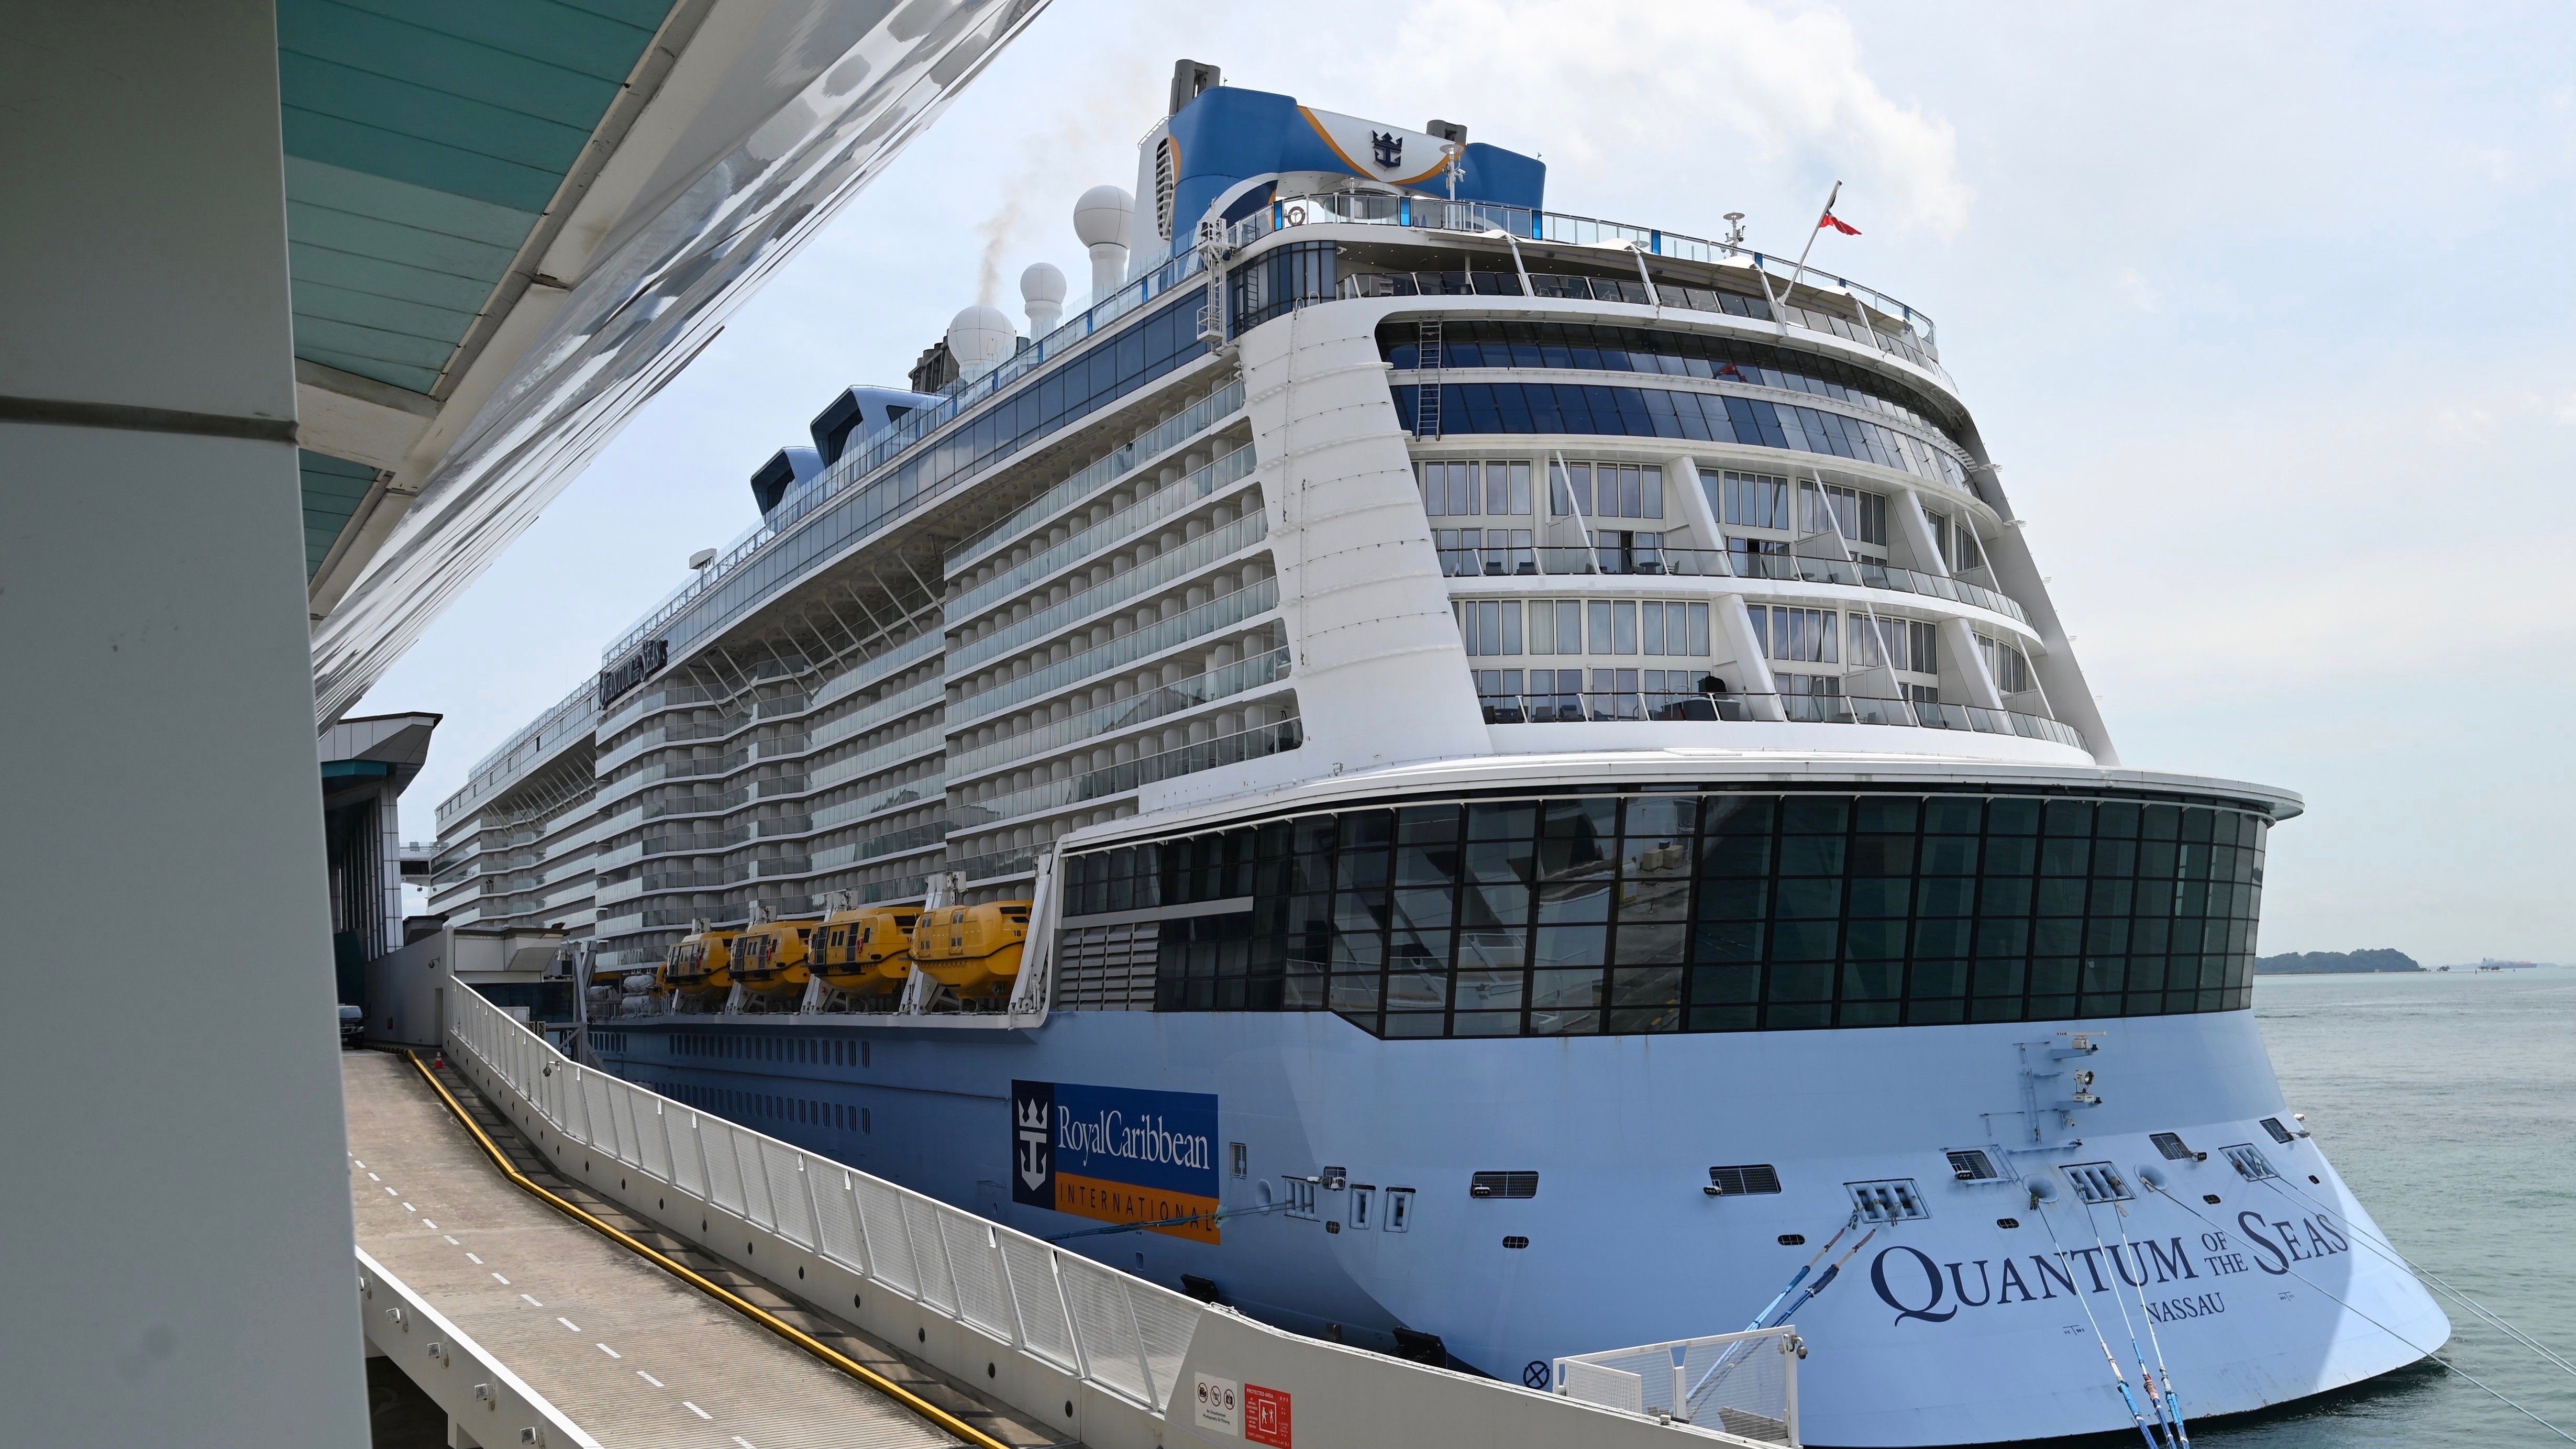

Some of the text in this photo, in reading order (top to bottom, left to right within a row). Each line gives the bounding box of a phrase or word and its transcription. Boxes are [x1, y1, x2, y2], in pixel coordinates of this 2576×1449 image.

[1059, 1182, 1213, 1232] INTERNATIONAL
[1870, 1211, 2349, 1327] QUANTUM OF THE SEAS
[2140, 1292, 2226, 1325] NASSAU
